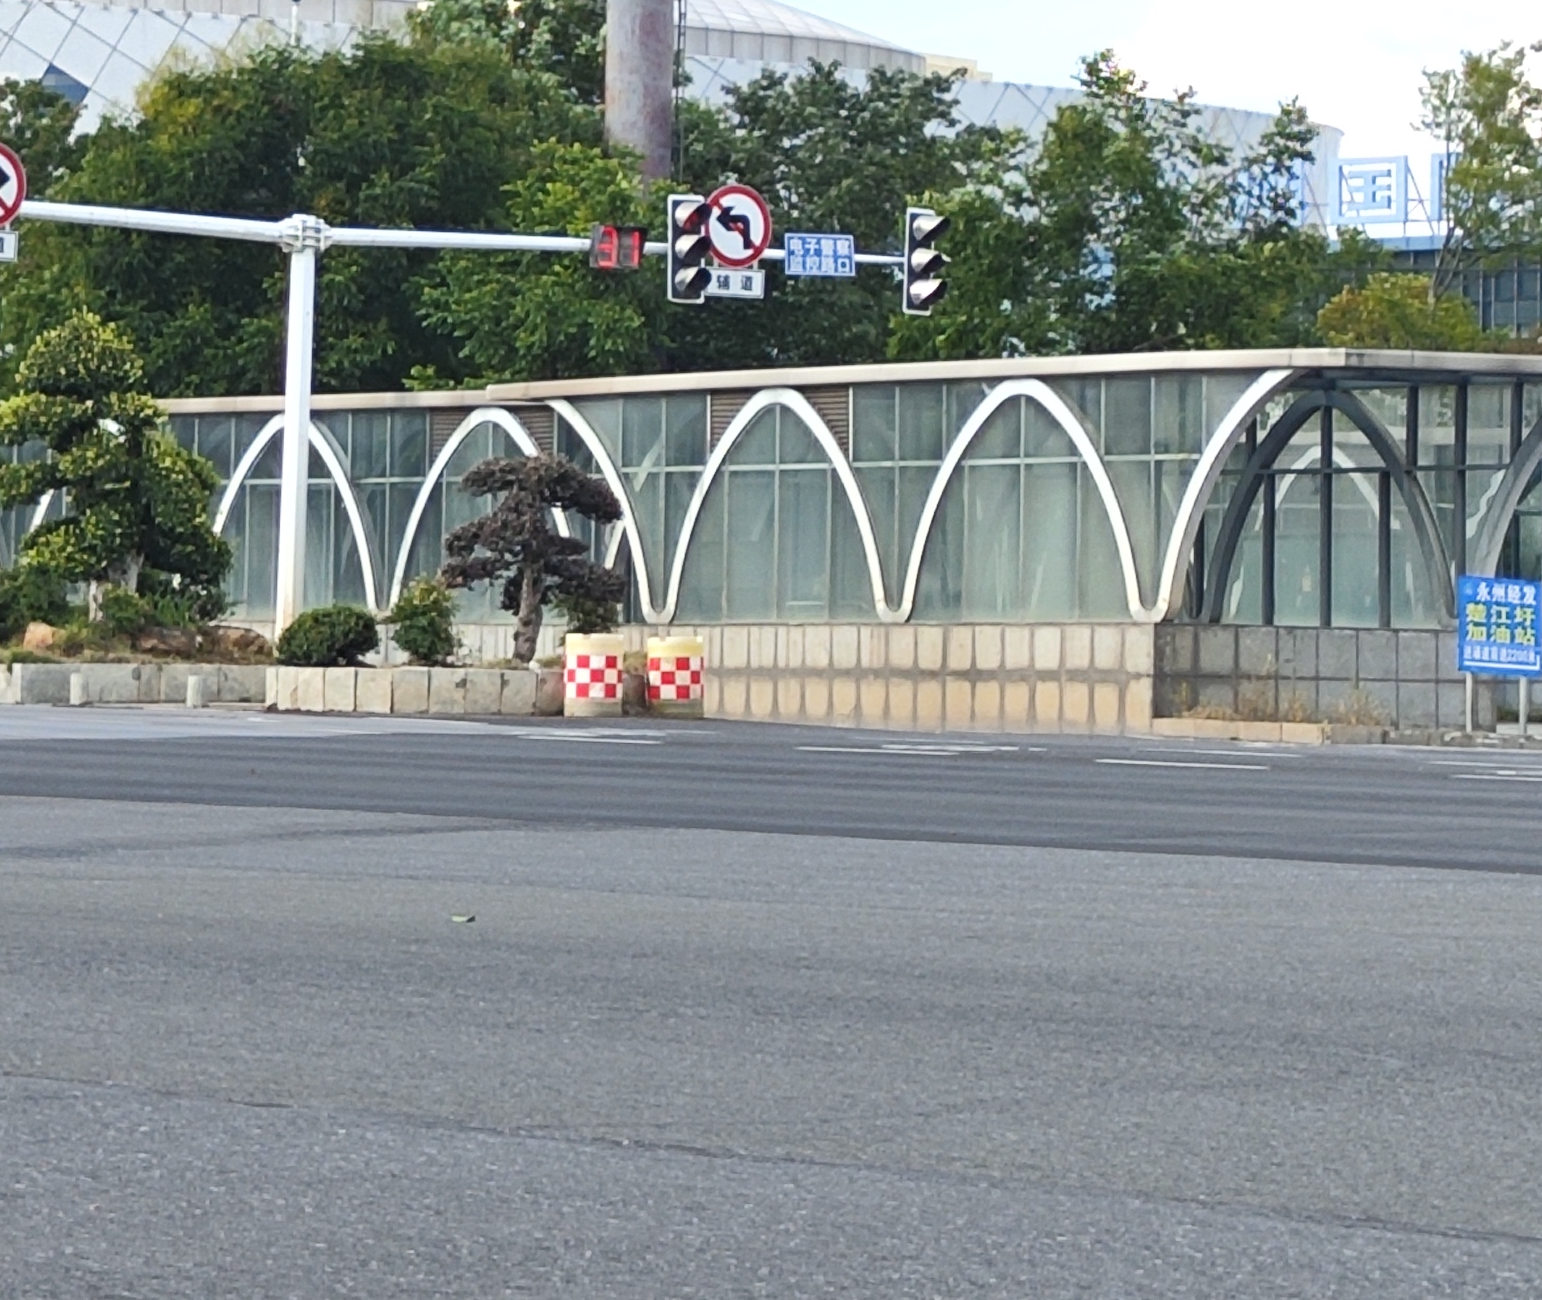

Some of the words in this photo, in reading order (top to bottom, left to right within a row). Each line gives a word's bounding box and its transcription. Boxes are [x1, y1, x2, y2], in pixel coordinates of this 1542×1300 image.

[790, 238, 851, 256] 电子警察
[1466, 622, 1535, 646] 加油站
